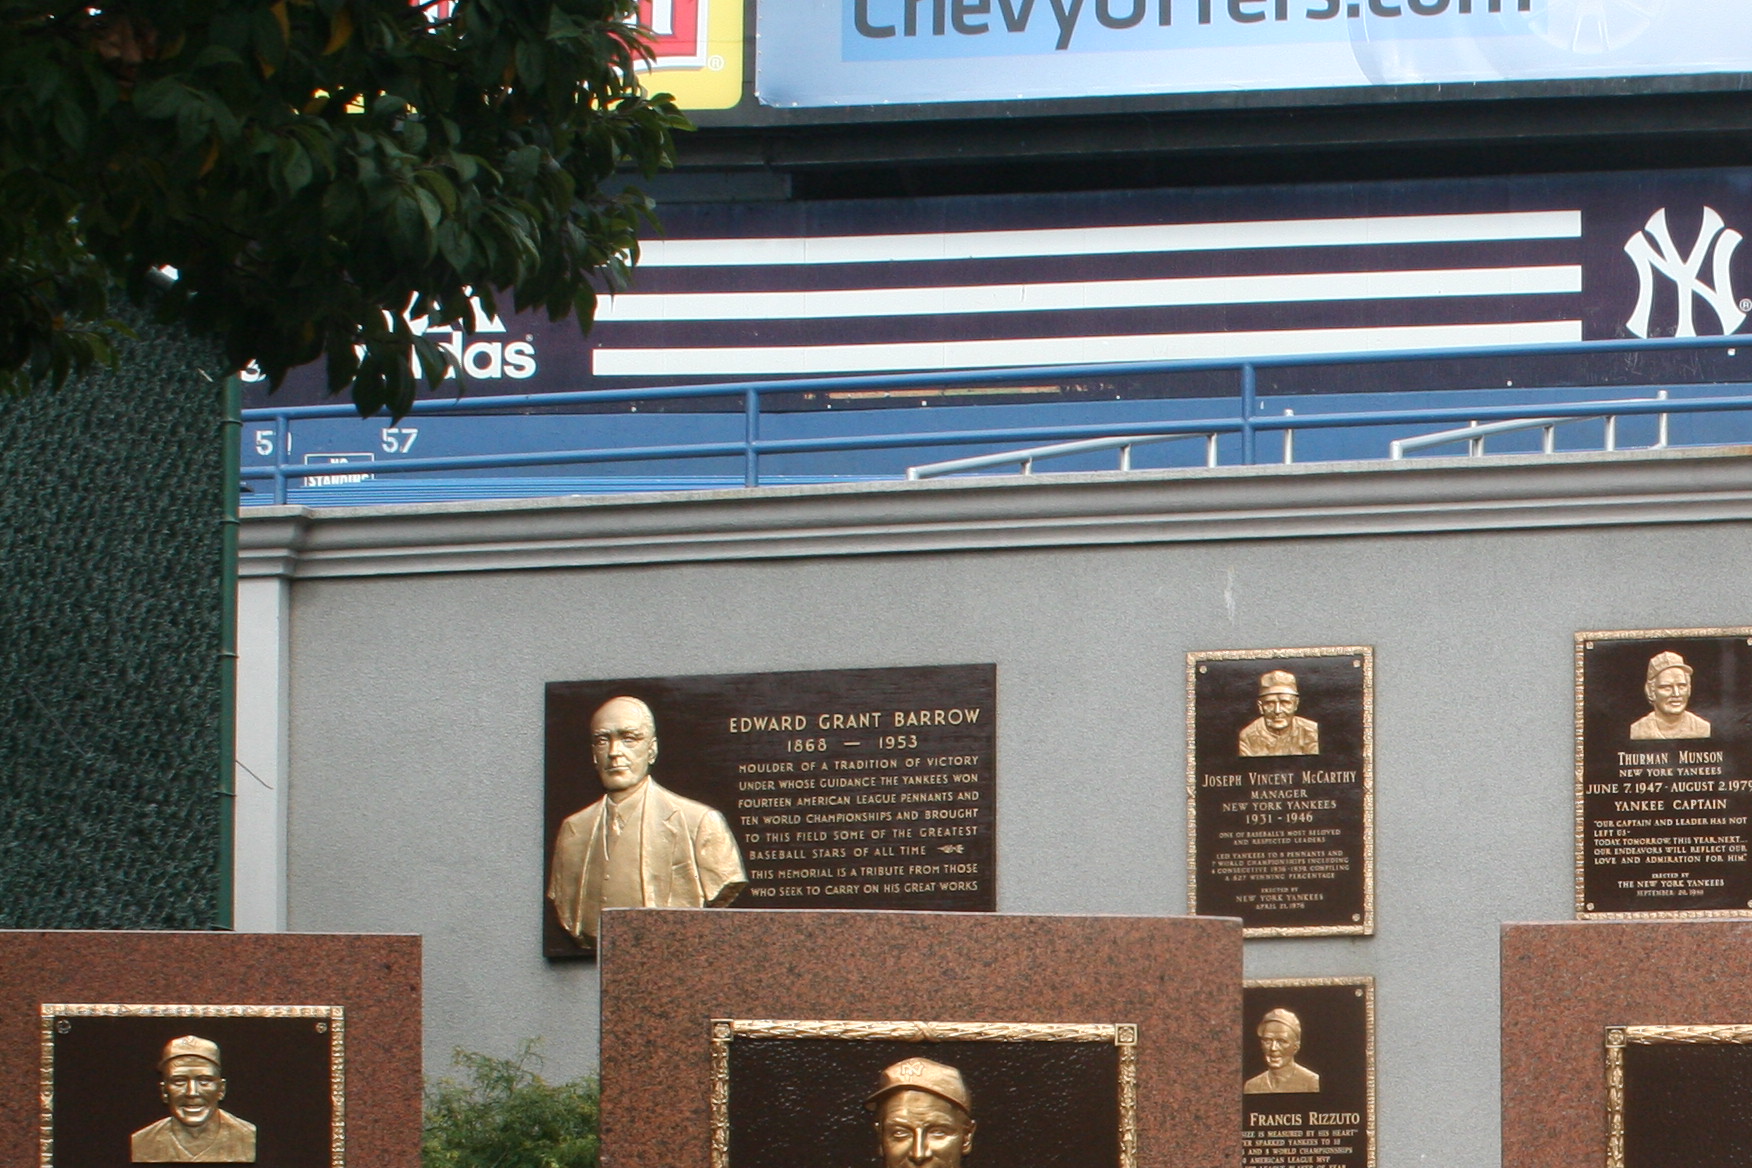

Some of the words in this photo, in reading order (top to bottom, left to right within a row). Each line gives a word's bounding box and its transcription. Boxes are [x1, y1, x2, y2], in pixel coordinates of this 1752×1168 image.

[1624, 206, 1747, 340] NY
[382, 427, 419, 453] 57
[730, 715, 806, 732] EDWARD
[819, 712, 881, 729] GRANT
[895, 709, 979, 727] BARROW
[739, 762, 793, 773] MOULDER
[801, 762, 815, 771] OF
[821, 762, 828, 770] A
[834, 759, 897, 769] TRADITION
[905, 758, 920, 767] OF
[927, 756, 978, 766] VICTORY
[1618, 752, 1668, 765] THURMAN
[1679, 751, 1722, 763] MUNSON
[1620, 769, 1643, 777] NEW
[1647, 768, 1673, 776] YORK
[1677, 767, 1722, 775] YANKEES
[1202, 774, 1241, 787] JOSEPH
[1249, 772, 1294, 785] VINCENT
[1251, 789, 1307, 799] MANAGER
[1223, 802, 1248, 811] NEW
[1252, 802, 1282, 810] YORK
[1287, 800, 1336, 809] YANKEES
[1615, 801, 1664, 811] YANKEE
[1673, 799, 1726, 810] CAPTAIN
[749, 850, 806, 860] BASEBALL
[812, 848, 846, 858] STARS
[854, 848, 868, 857] OF
[874, 847, 894, 856] ALL
[900, 846, 925, 855] TIME
[1250, 1113, 1302, 1126] FRANCIS
[1309, 1112, 1360, 1125] RIZZUTO
